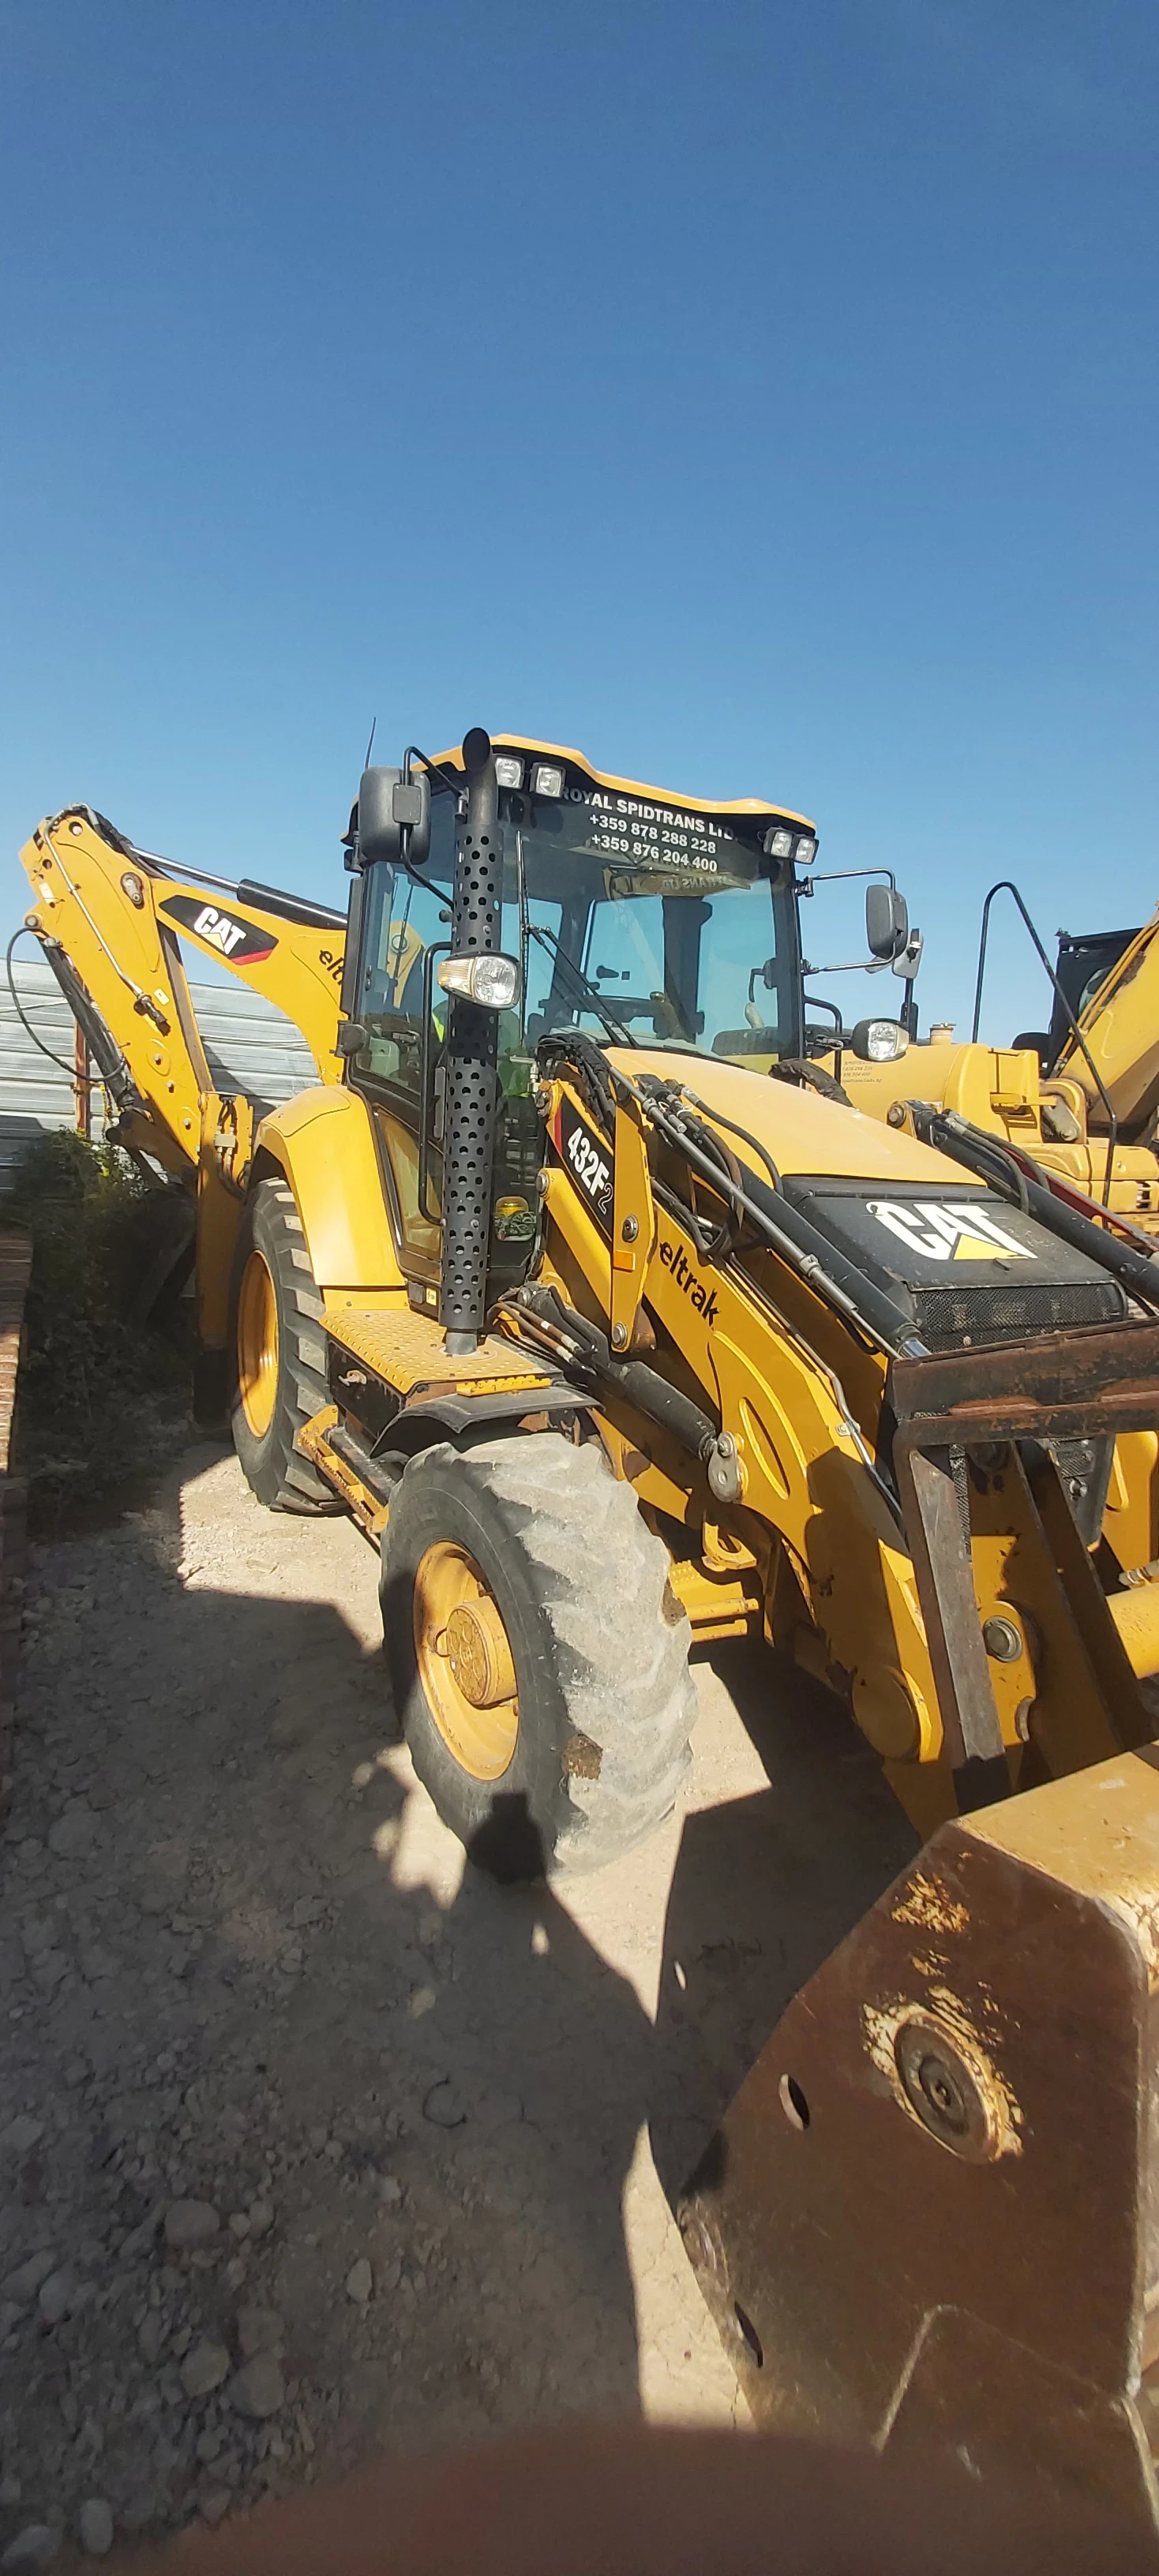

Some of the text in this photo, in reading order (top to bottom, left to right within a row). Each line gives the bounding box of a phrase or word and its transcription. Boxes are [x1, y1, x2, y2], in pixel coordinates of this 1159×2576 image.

[562, 786, 613, 811] ROYAL
[616, 799, 705, 833] SPIDTRANS
[590, 814, 716, 854] +359 878 288 228
[591, 833, 718, 873] +359 876 204 400
[193, 906, 247, 955] CAT
[865, 1201, 1039, 1261] CAT
[659, 1241, 720, 1327] eltrak
